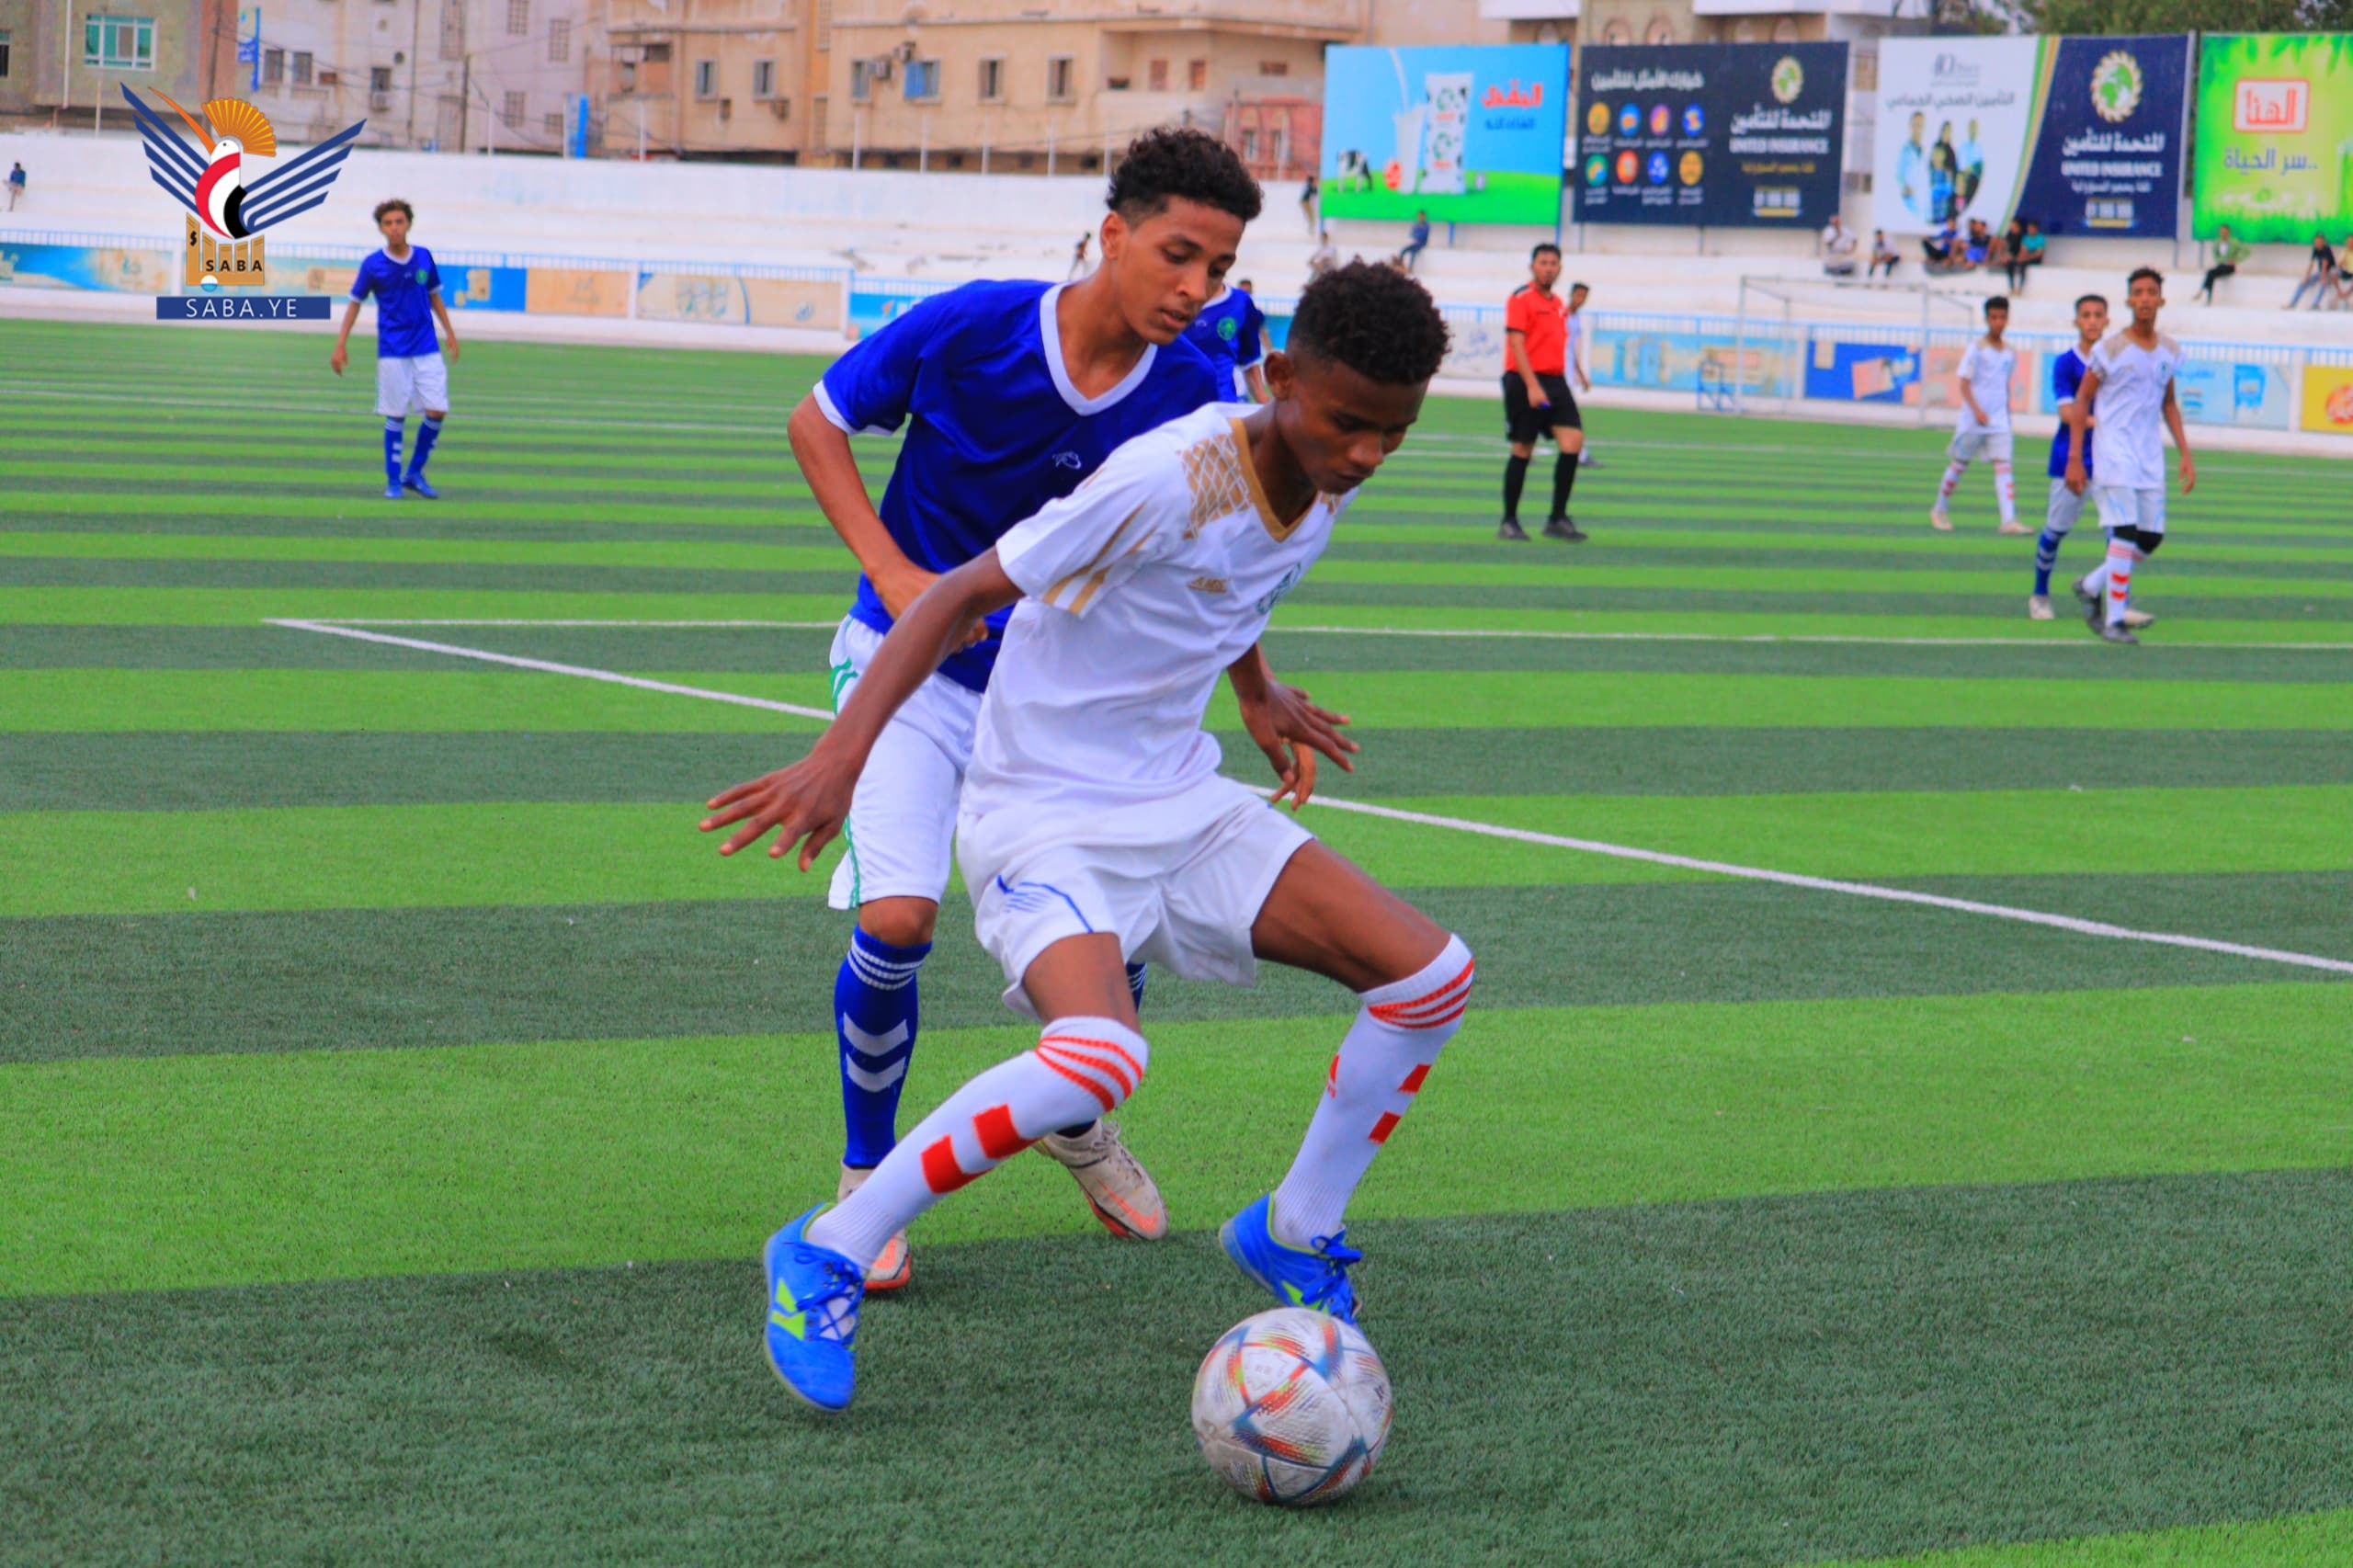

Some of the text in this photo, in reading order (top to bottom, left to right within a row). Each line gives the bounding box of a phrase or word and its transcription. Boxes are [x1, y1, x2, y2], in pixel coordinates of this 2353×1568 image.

[1730, 101, 1833, 135] المتحدة للتأمين
[2245, 88, 2297, 125] الهنا
[1728, 137, 1767, 154] UNITED
[2062, 126, 2166, 157] المتحدة للتأمين
[2061, 160, 2099, 177] UNITED
[2223, 146, 2277, 176] الحياة
